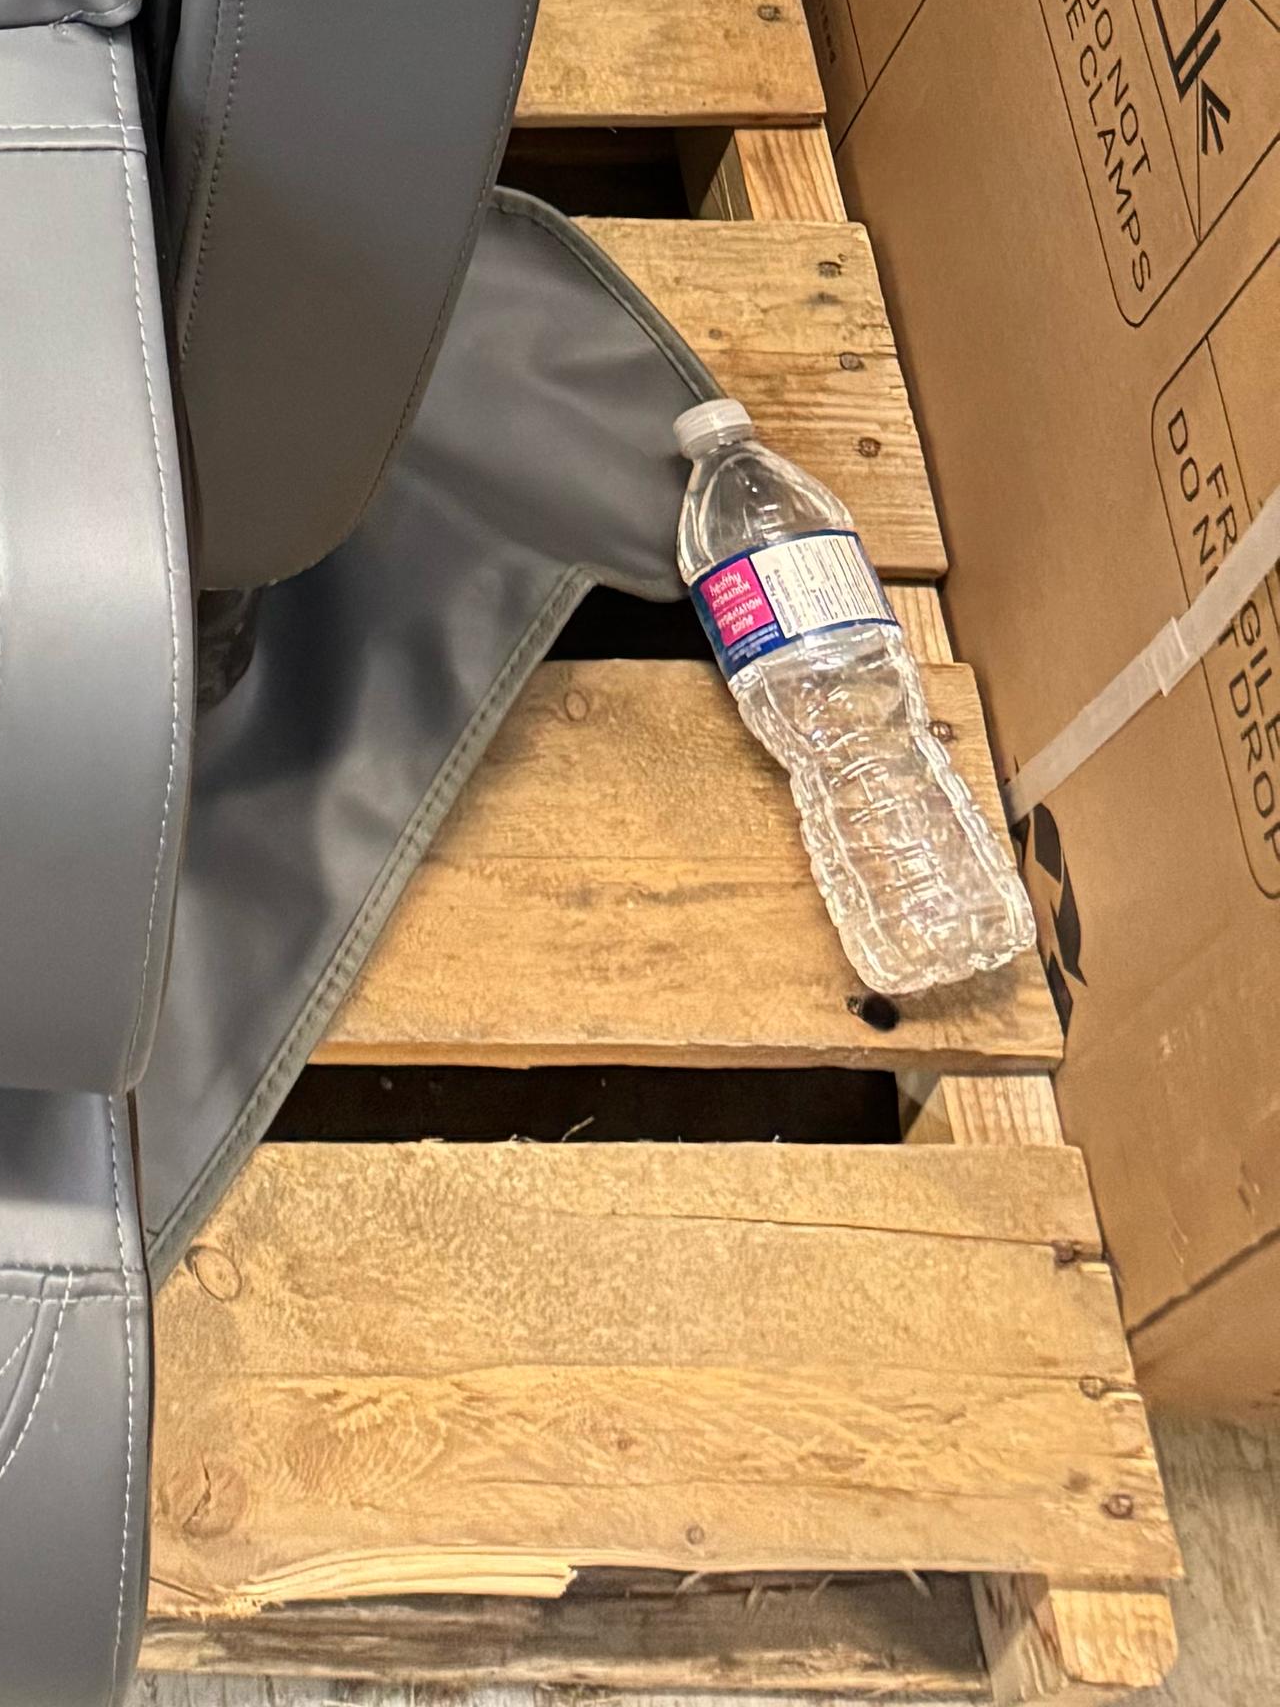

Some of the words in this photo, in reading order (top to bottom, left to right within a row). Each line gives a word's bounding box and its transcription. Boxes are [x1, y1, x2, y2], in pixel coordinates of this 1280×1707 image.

[1077, 42, 1154, 295] CLAMPS
[1101, 55, 1154, 176] NOT
[1167, 405, 1201, 504] DO
[1192, 513, 1240, 651] NT
[1206, 462, 1280, 763] FRGILE
